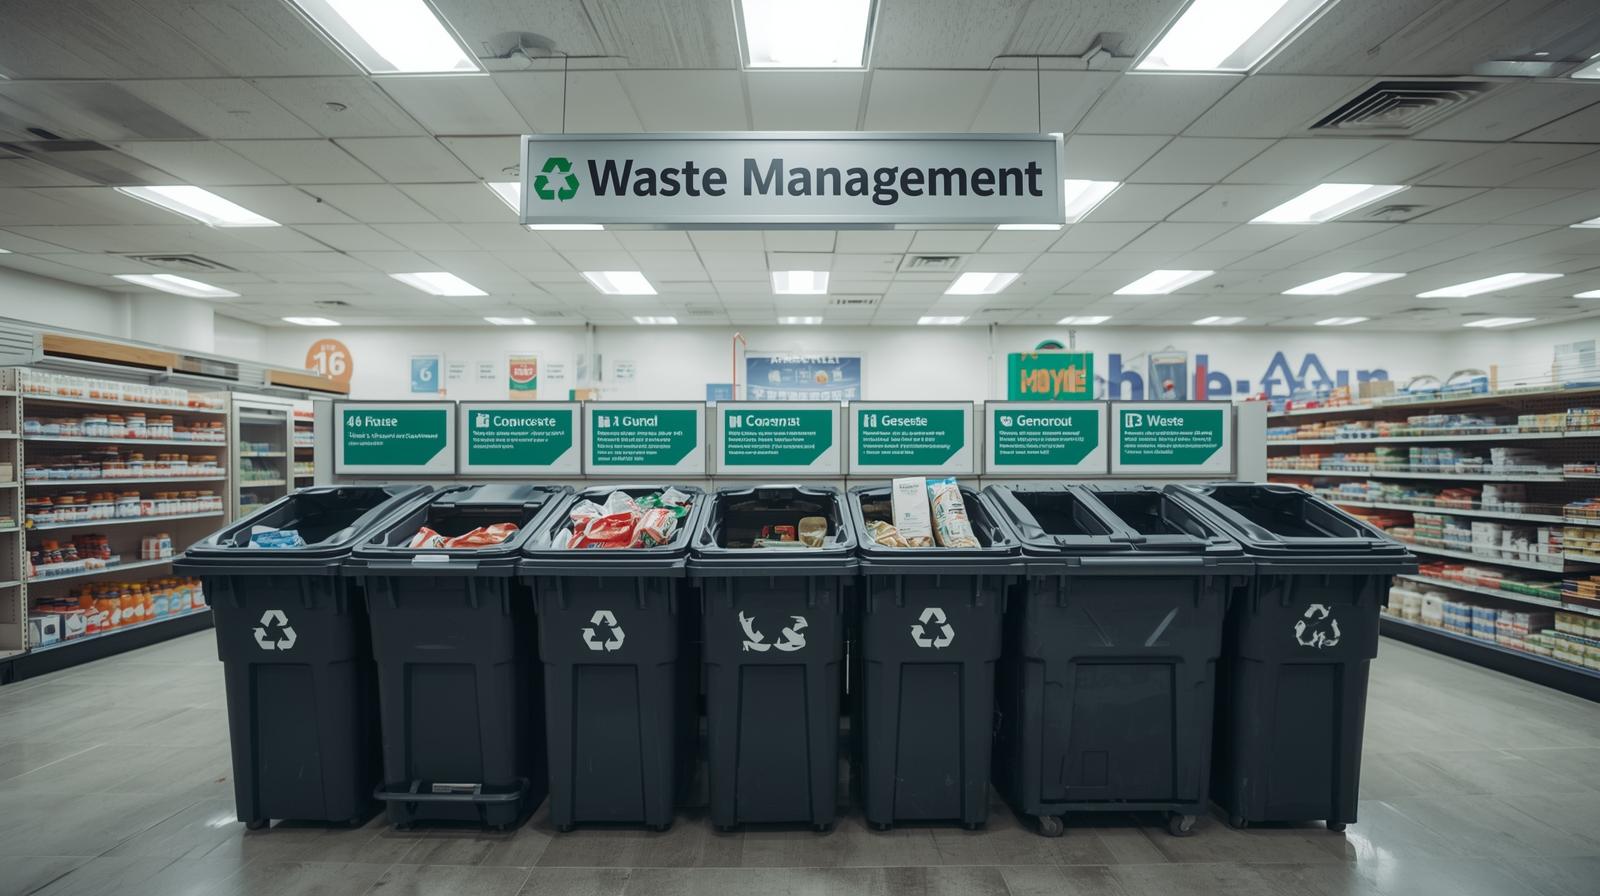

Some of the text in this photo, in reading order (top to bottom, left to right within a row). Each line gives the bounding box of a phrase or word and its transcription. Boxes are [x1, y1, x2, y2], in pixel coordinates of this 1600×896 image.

[587, 158, 1043, 206] Waste Management
[313, 351, 346, 376] 16
[419, 367, 432, 382] 6
